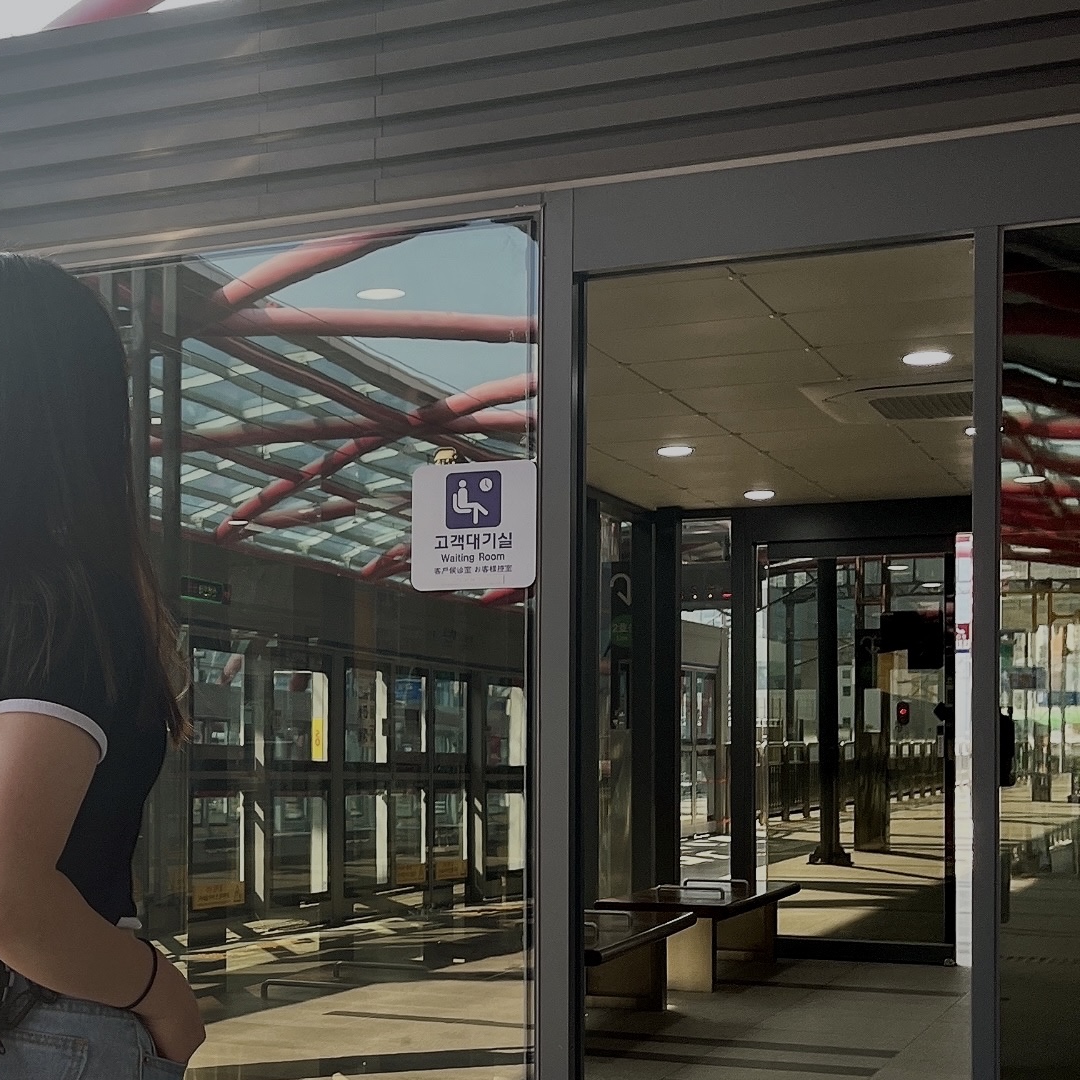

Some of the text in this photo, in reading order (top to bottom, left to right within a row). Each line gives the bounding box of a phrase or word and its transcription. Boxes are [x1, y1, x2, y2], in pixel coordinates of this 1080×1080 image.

[434, 532, 512, 551] 고객대기실
[441, 552, 505, 564] Waiting Room
